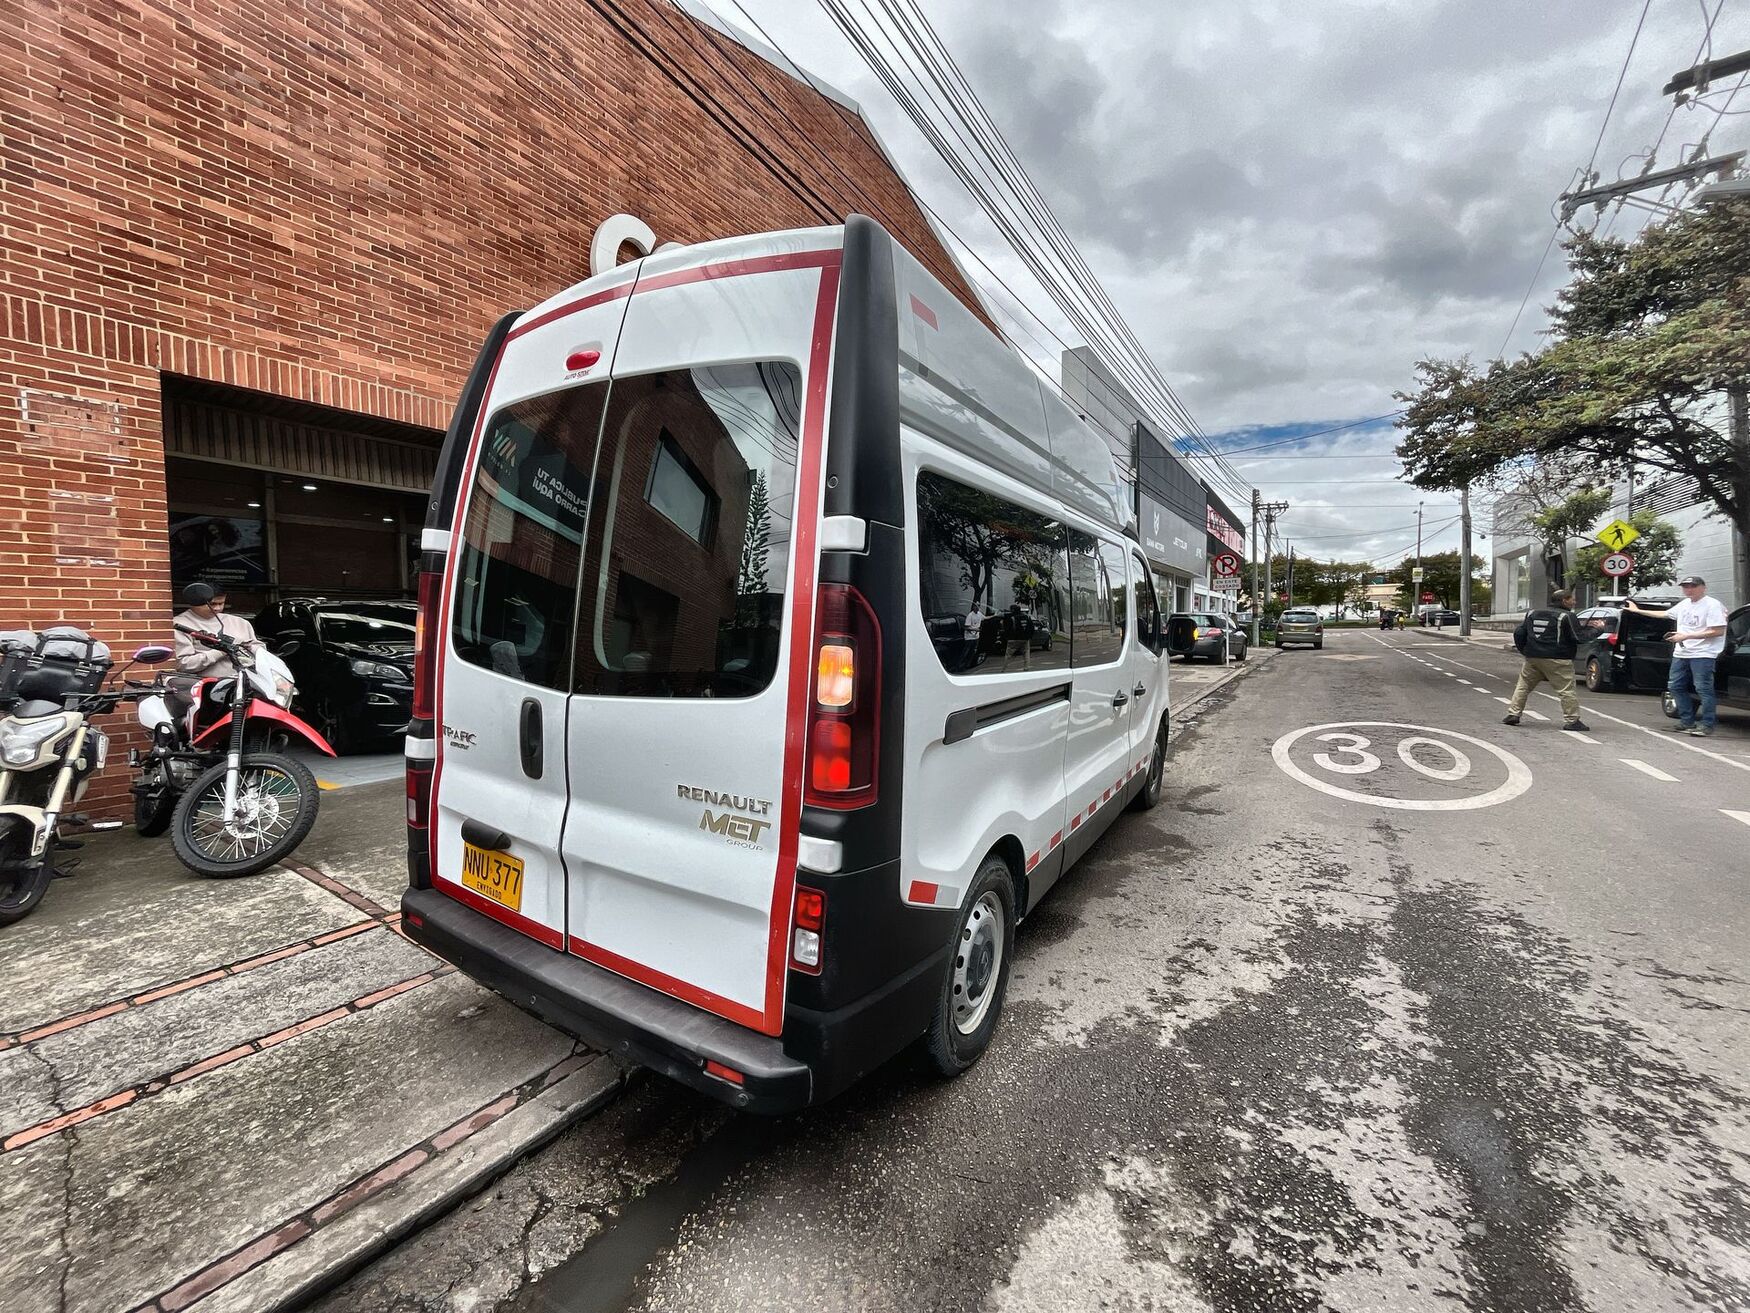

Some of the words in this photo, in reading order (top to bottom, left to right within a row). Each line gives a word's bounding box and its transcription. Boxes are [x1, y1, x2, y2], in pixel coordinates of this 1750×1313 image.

[1607, 559, 1628, 570] 30
[1313, 733, 1471, 781] 30
[677, 784, 773, 815] RENAULT
[699, 809, 771, 843] MET
[726, 839, 763, 851] GROUP
[464, 846, 489, 880] NNU
[493, 859, 521, 895] 377
